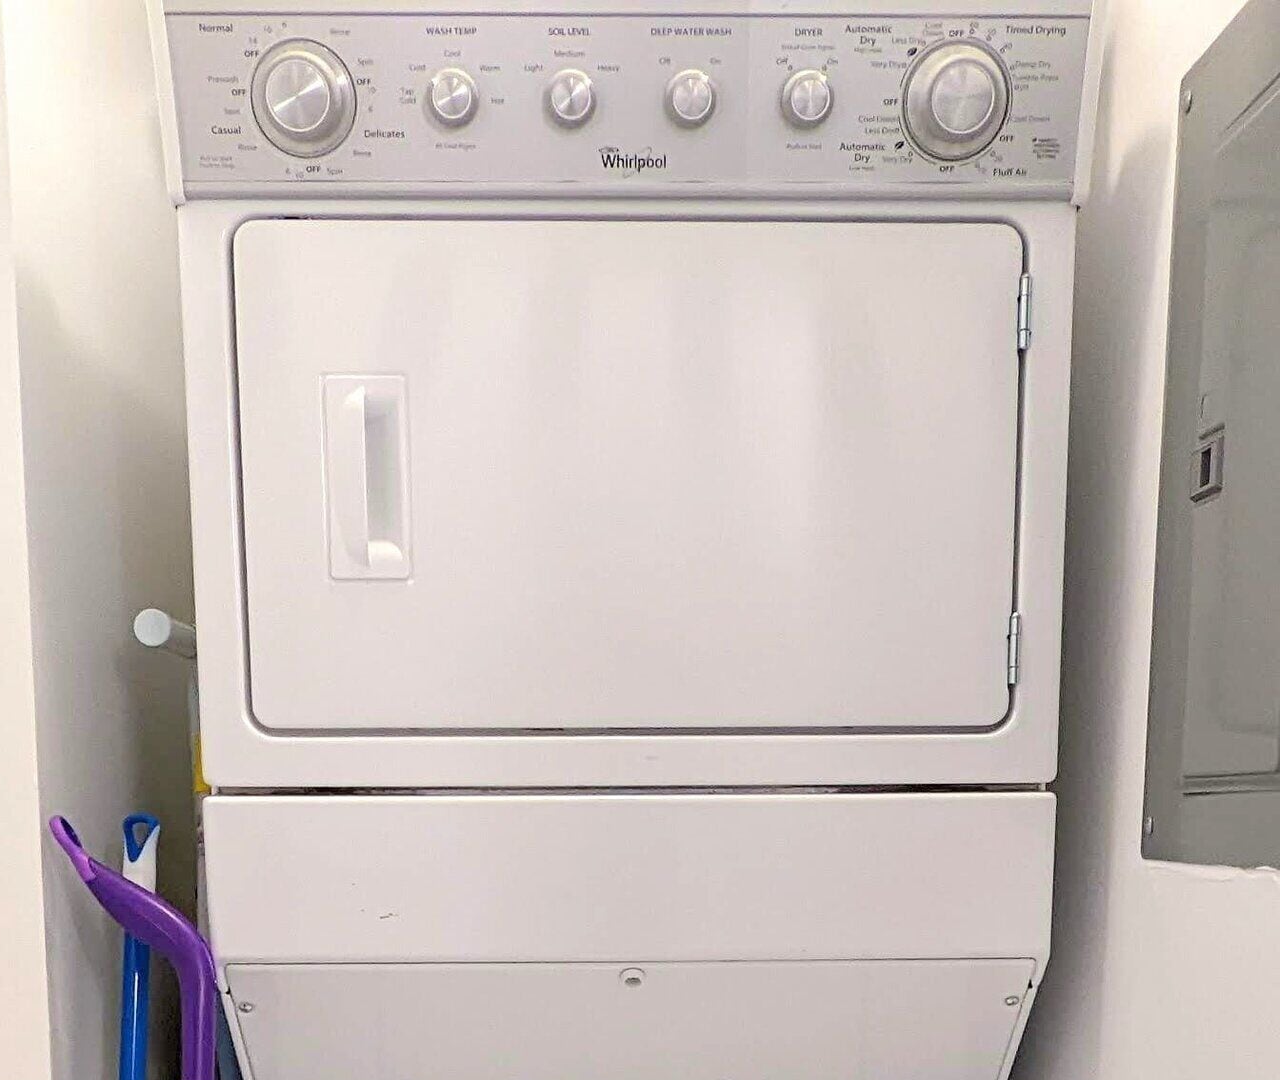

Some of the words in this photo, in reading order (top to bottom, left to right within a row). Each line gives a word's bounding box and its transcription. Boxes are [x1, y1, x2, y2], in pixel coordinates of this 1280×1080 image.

[199, 23, 233, 32] Normal
[426, 27, 452, 36] WASH
[453, 27, 477, 36] TEMP
[549, 27, 566, 36] SOIL
[567, 27, 590, 36] LEVEL
[651, 27, 673, 36] DEEP
[674, 27, 704, 36] WATER
[706, 27, 732, 36] WASH
[845, 24, 892, 34] Automatic
[1006, 25, 1034, 35] Timed
[1035, 25, 1067, 37] Drying
[794, 28, 823, 37] DRYER
[860, 35, 877, 47] Dry
[244, 50, 259, 58] OFF
[524, 63, 543, 73] Light
[597, 64, 620, 73] Heavy
[231, 89, 246, 97] OFF
[883, 98, 898, 106] OFF
[211, 125, 241, 135] Casual
[364, 129, 405, 139] Delicates
[839, 142, 886, 152] Automatic
[601, 153, 667, 173] Whirlpool
[854, 153, 871, 164] Dry
[306, 165, 320, 173] OFF
[939, 165, 955, 173] OFF
[993, 168, 1013, 177] Fluff
[1015, 168, 1027, 177] Air
